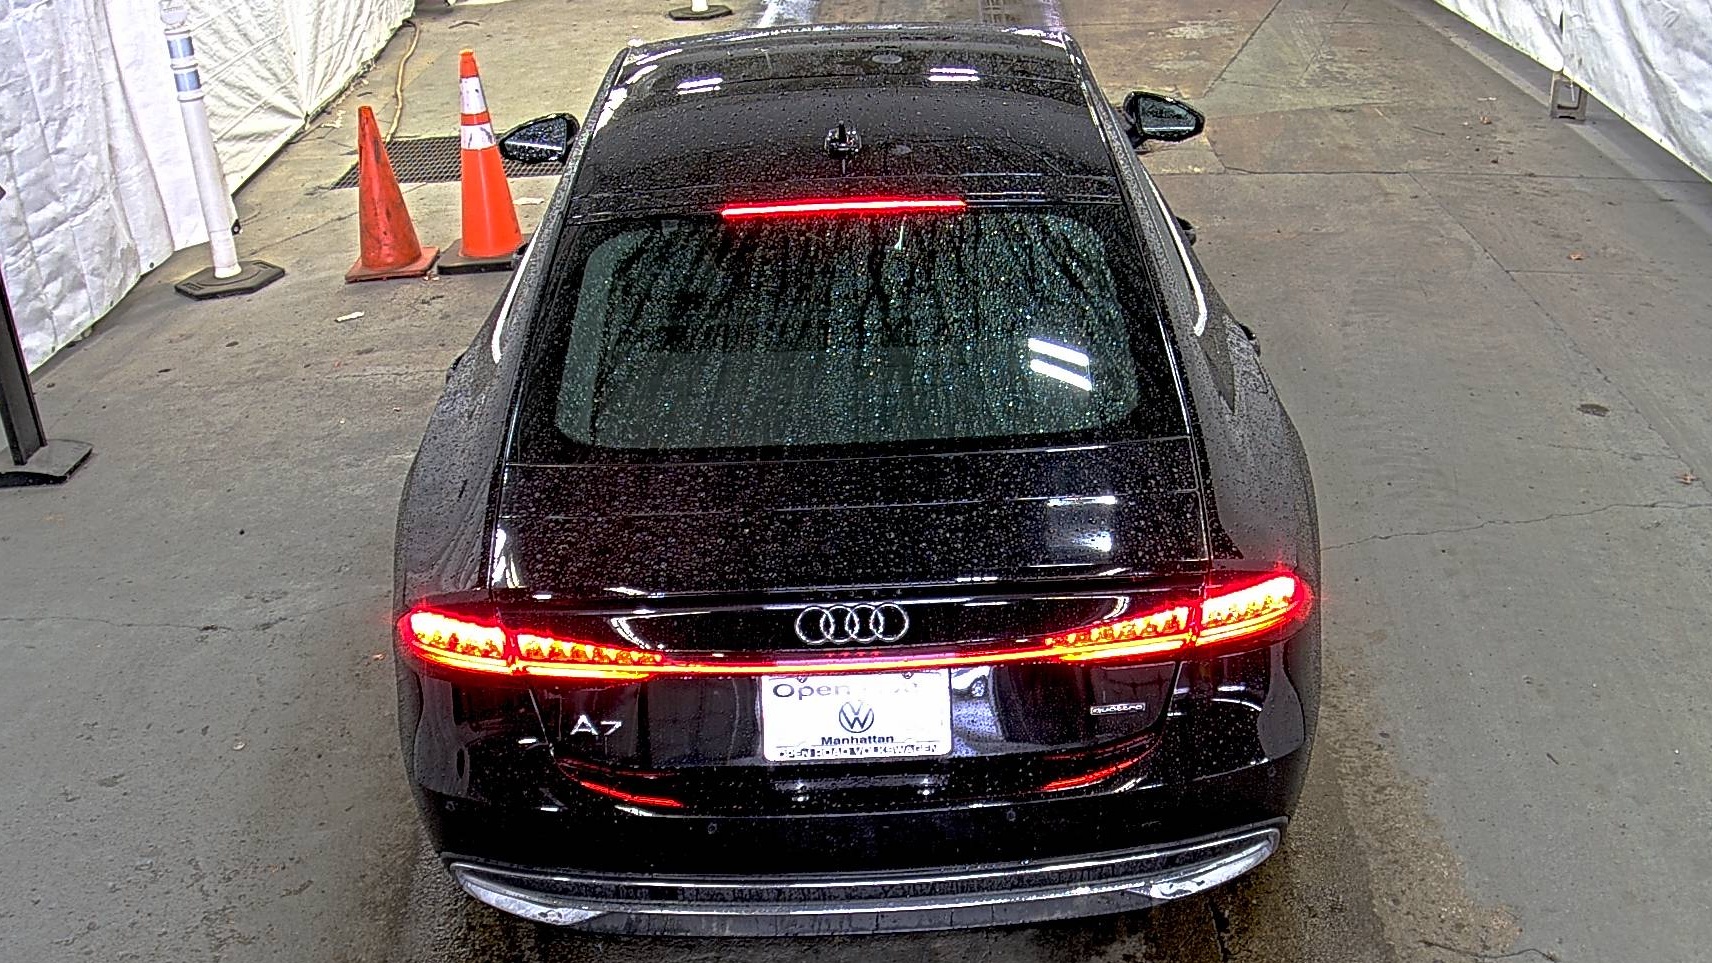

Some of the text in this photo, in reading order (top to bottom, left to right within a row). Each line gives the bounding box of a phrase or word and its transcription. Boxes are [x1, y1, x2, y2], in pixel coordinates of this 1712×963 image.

[772, 683, 850, 701] Open
[570, 714, 622, 736] A7
[820, 735, 895, 746] Manhattan
